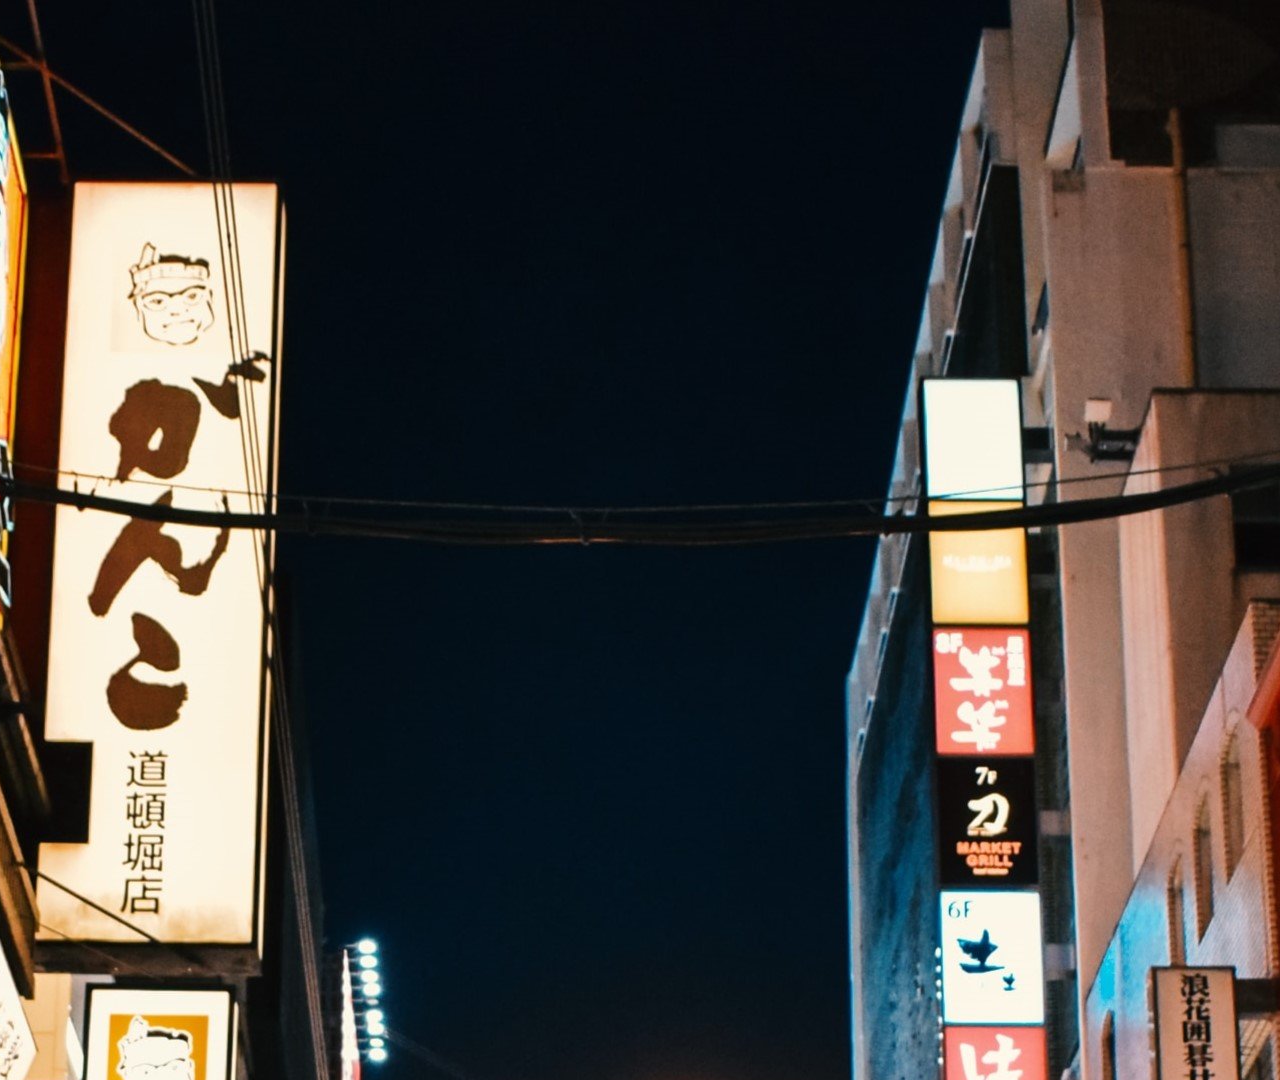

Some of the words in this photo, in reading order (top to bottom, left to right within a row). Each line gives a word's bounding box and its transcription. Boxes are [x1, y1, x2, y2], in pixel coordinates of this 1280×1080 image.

[88, 351, 271, 732] がんこ
[121, 750, 168, 917] 道頓堀店
[956, 841, 1021, 855] MARKET
[966, 854, 1013, 868] GRILL
